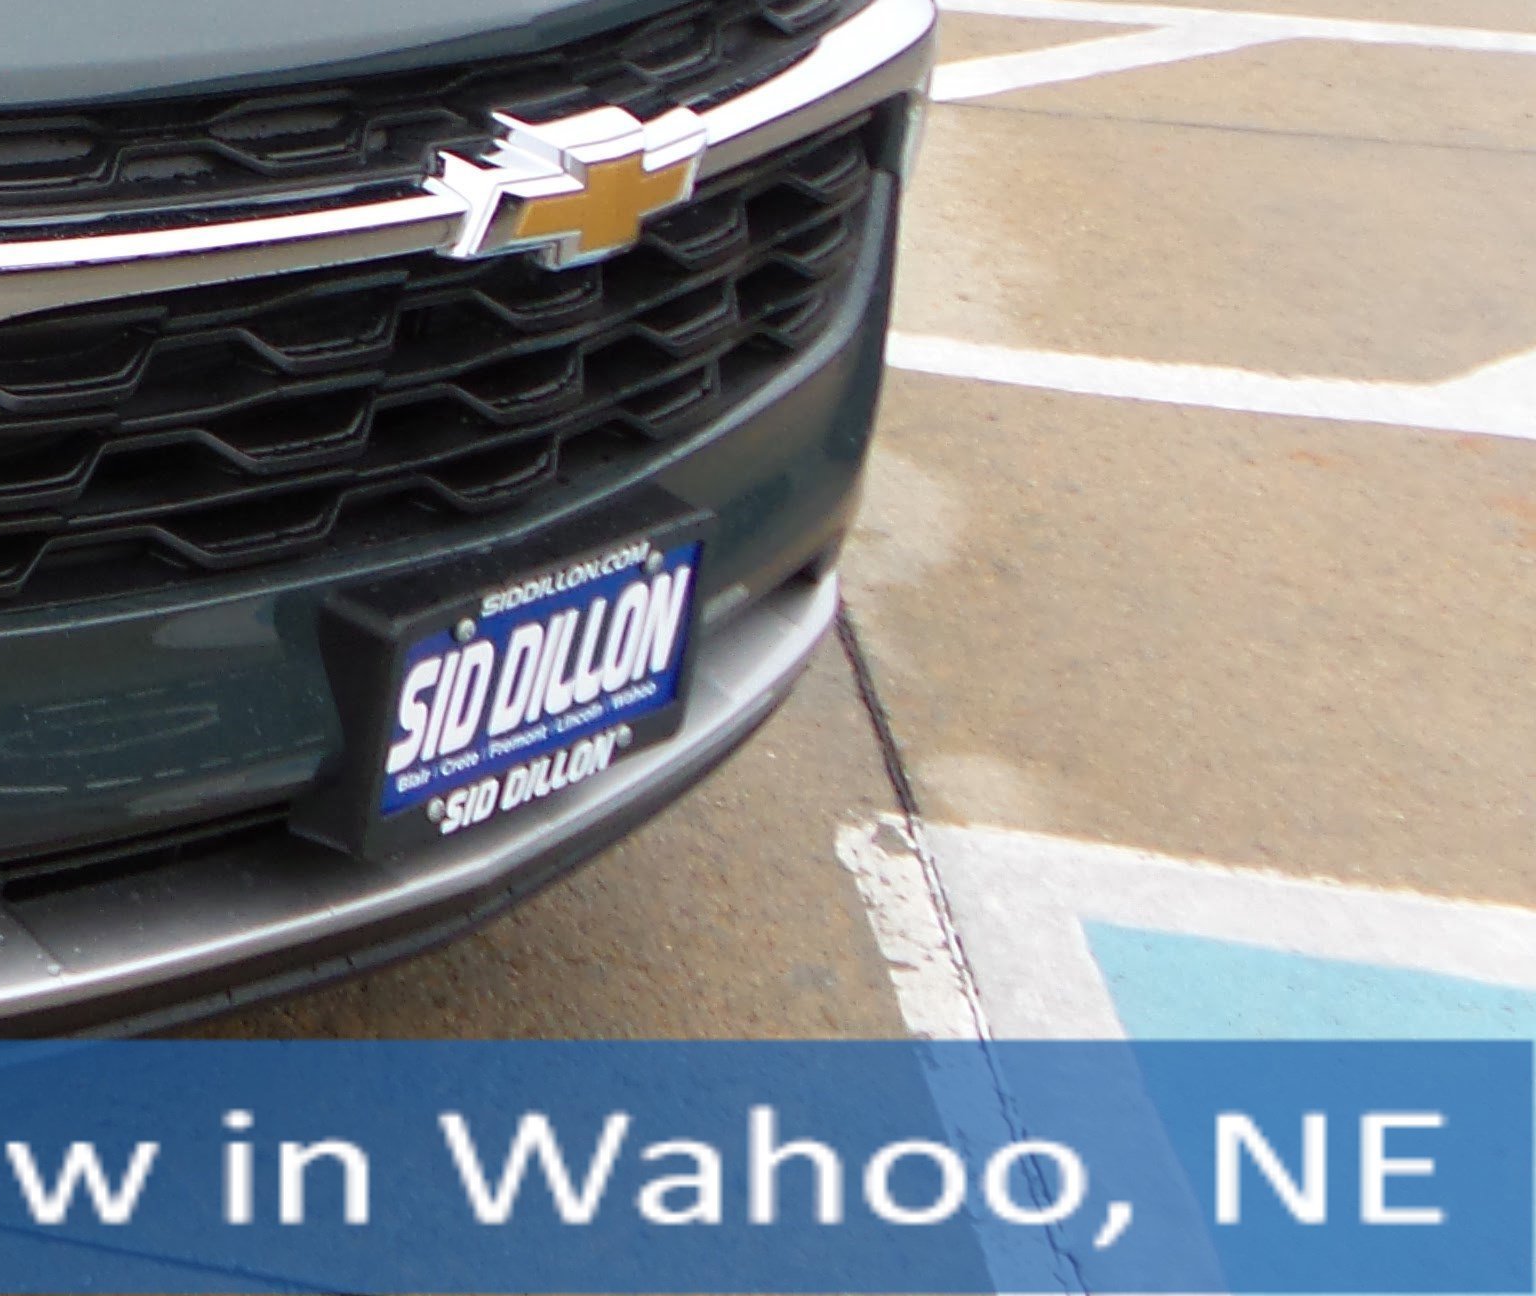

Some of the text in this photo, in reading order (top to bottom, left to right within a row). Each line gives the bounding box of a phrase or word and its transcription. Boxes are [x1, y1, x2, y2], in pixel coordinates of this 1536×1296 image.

[481, 540, 651, 617] SIDDILLON.COM
[385, 565, 692, 774] SID DILLON
[439, 727, 617, 835] SID DILLON
